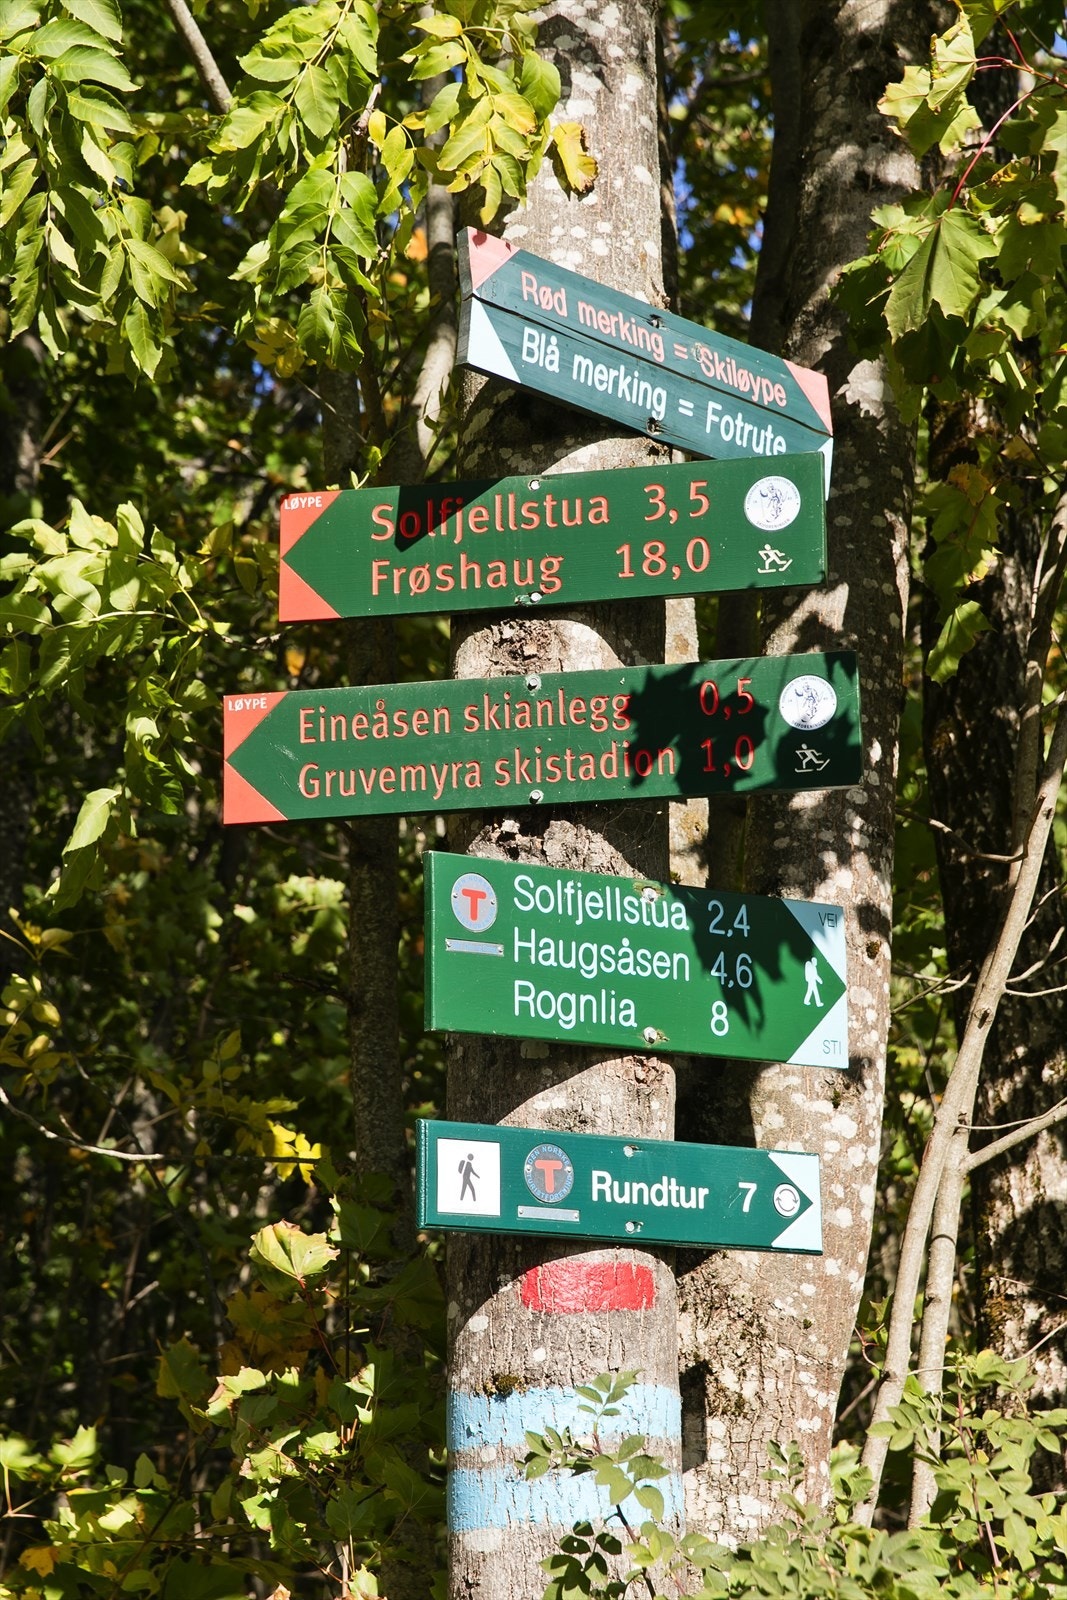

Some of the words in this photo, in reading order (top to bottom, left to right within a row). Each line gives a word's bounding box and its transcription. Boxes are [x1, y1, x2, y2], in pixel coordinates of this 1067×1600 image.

[520, 271, 567, 318] Rød
[577, 300, 665, 363] merking
[673, 342, 688, 361] =
[699, 346, 787, 407] Skiløype
[521, 326, 560, 373] Blå
[573, 353, 667, 421] merking
[678, 398, 694, 417] =
[705, 400, 787, 456] Fotrute
[284, 495, 323, 511] LØYPE
[370, 493, 610, 544] Solfjellstua
[643, 480, 710, 524] 3,5
[372, 552, 564, 594] Frøshaug
[615, 536, 711, 580] 18,0
[228, 697, 267, 711] LØYPE
[299, 699, 450, 744] Eineåsen
[463, 688, 632, 733] skianlegg
[699, 678, 755, 720] 0,5
[299, 759, 482, 800] Gruvemyra
[494, 740, 677, 787] skistadion
[700, 734, 756, 777] 1,0
[513, 874, 689, 931] Solfjellstua
[708, 899, 751, 937] 2,4
[818, 911, 838, 928] VEI
[513, 926, 690, 982] Haugsåsen
[710, 951, 753, 988] 4,6
[513, 979, 638, 1029] Rognlia
[710, 1000, 730, 1037] 8
[822, 1039, 842, 1055] STI
[591, 1170, 710, 1210] Rundtur
[737, 1182, 758, 1213] 7
